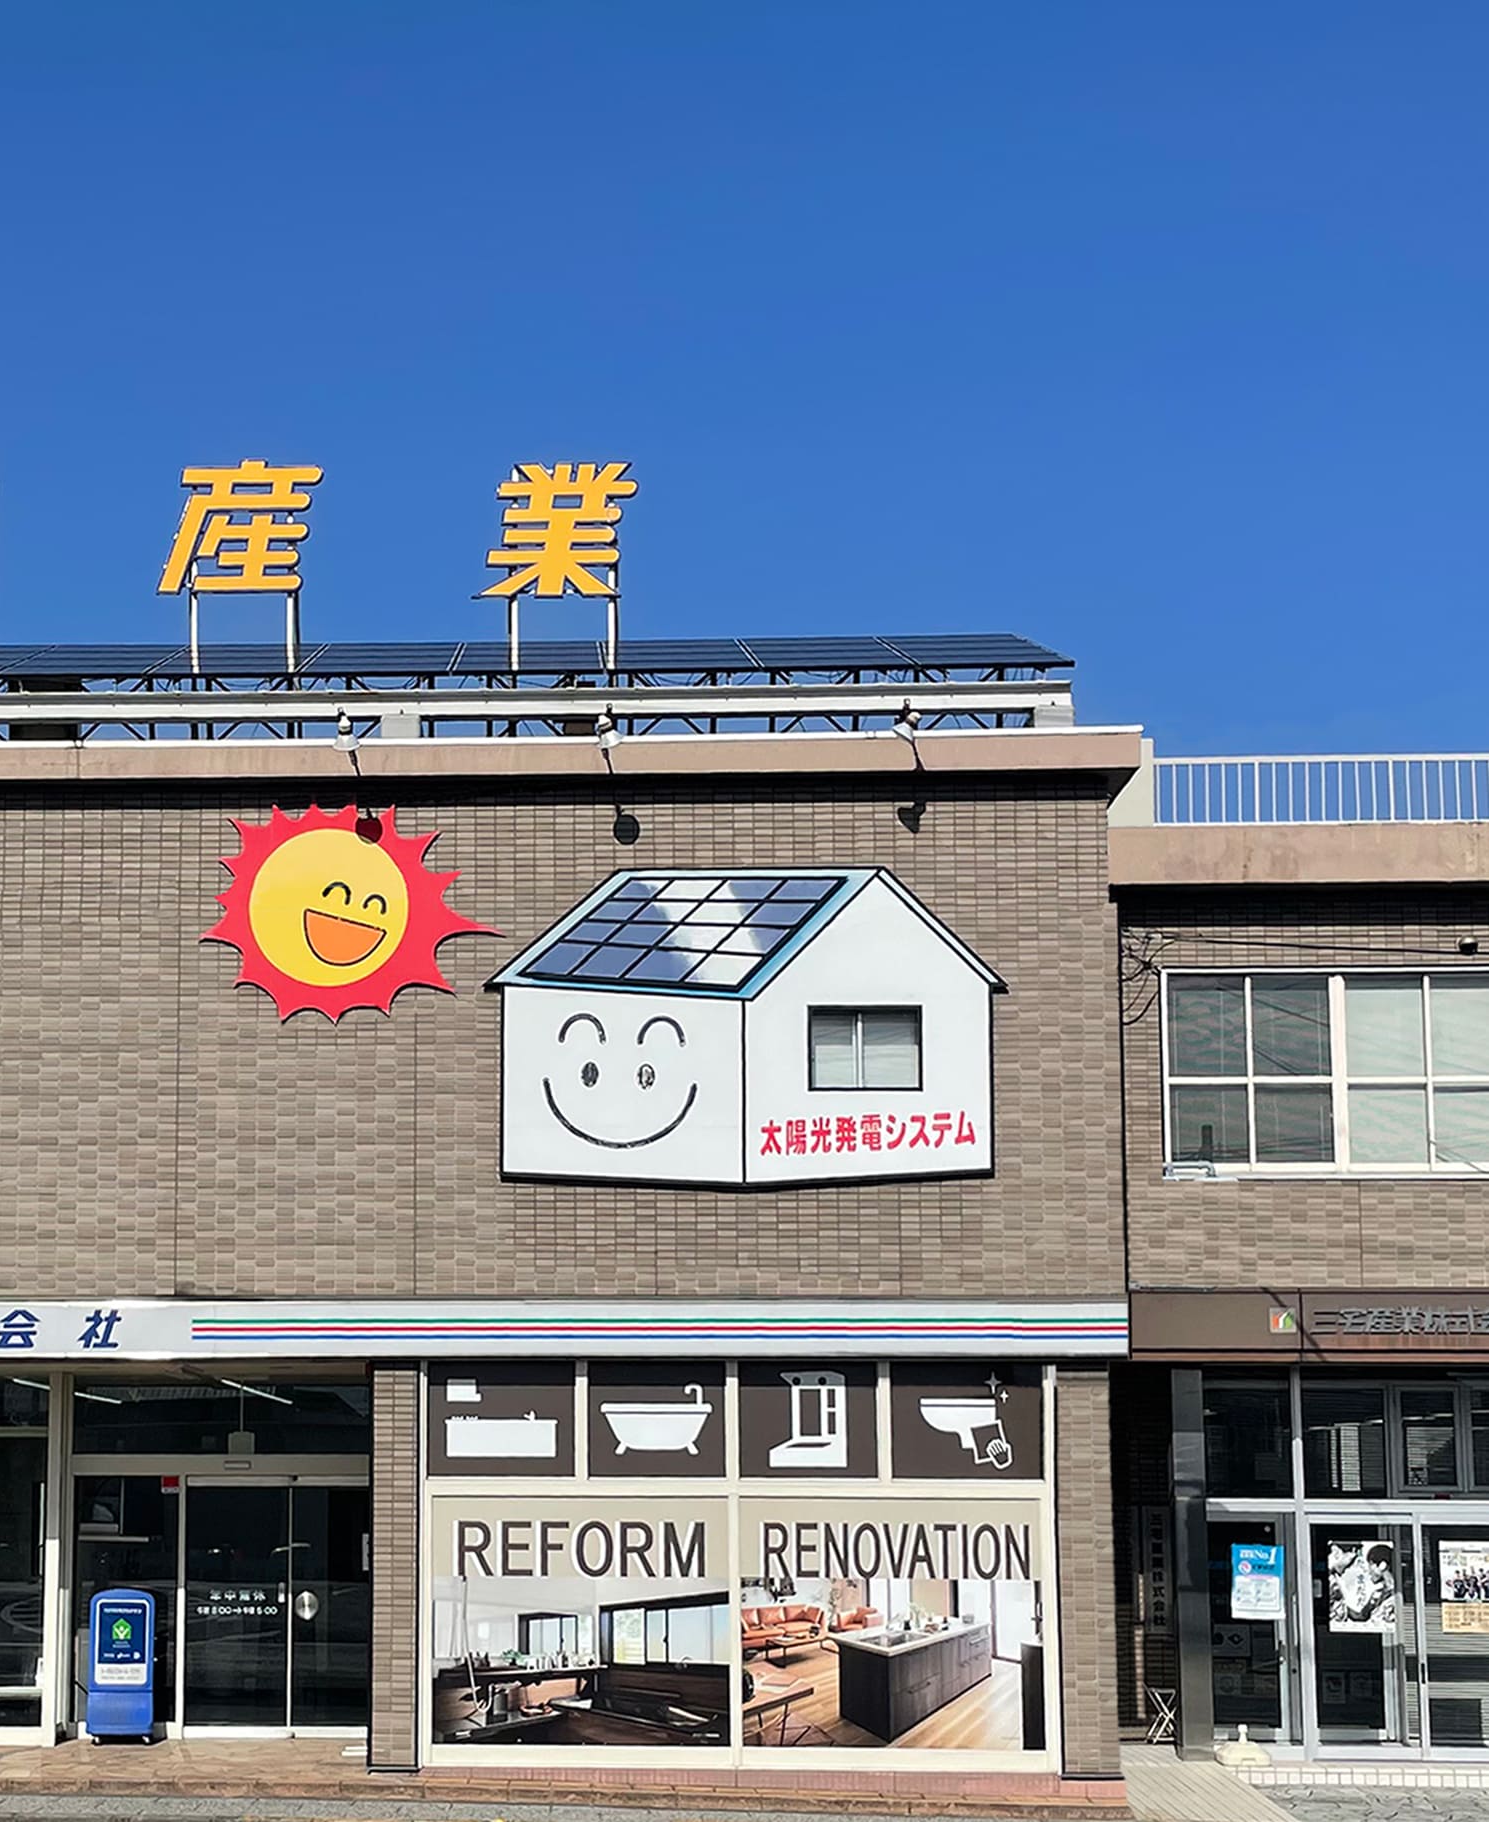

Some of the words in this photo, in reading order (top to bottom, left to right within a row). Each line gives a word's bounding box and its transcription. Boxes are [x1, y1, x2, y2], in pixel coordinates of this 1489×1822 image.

[760, 1110, 976, 1155] 太陽光発電システム
[456, 1520, 706, 1578] REFORM
[762, 1522, 1030, 1580] RENOVATION
